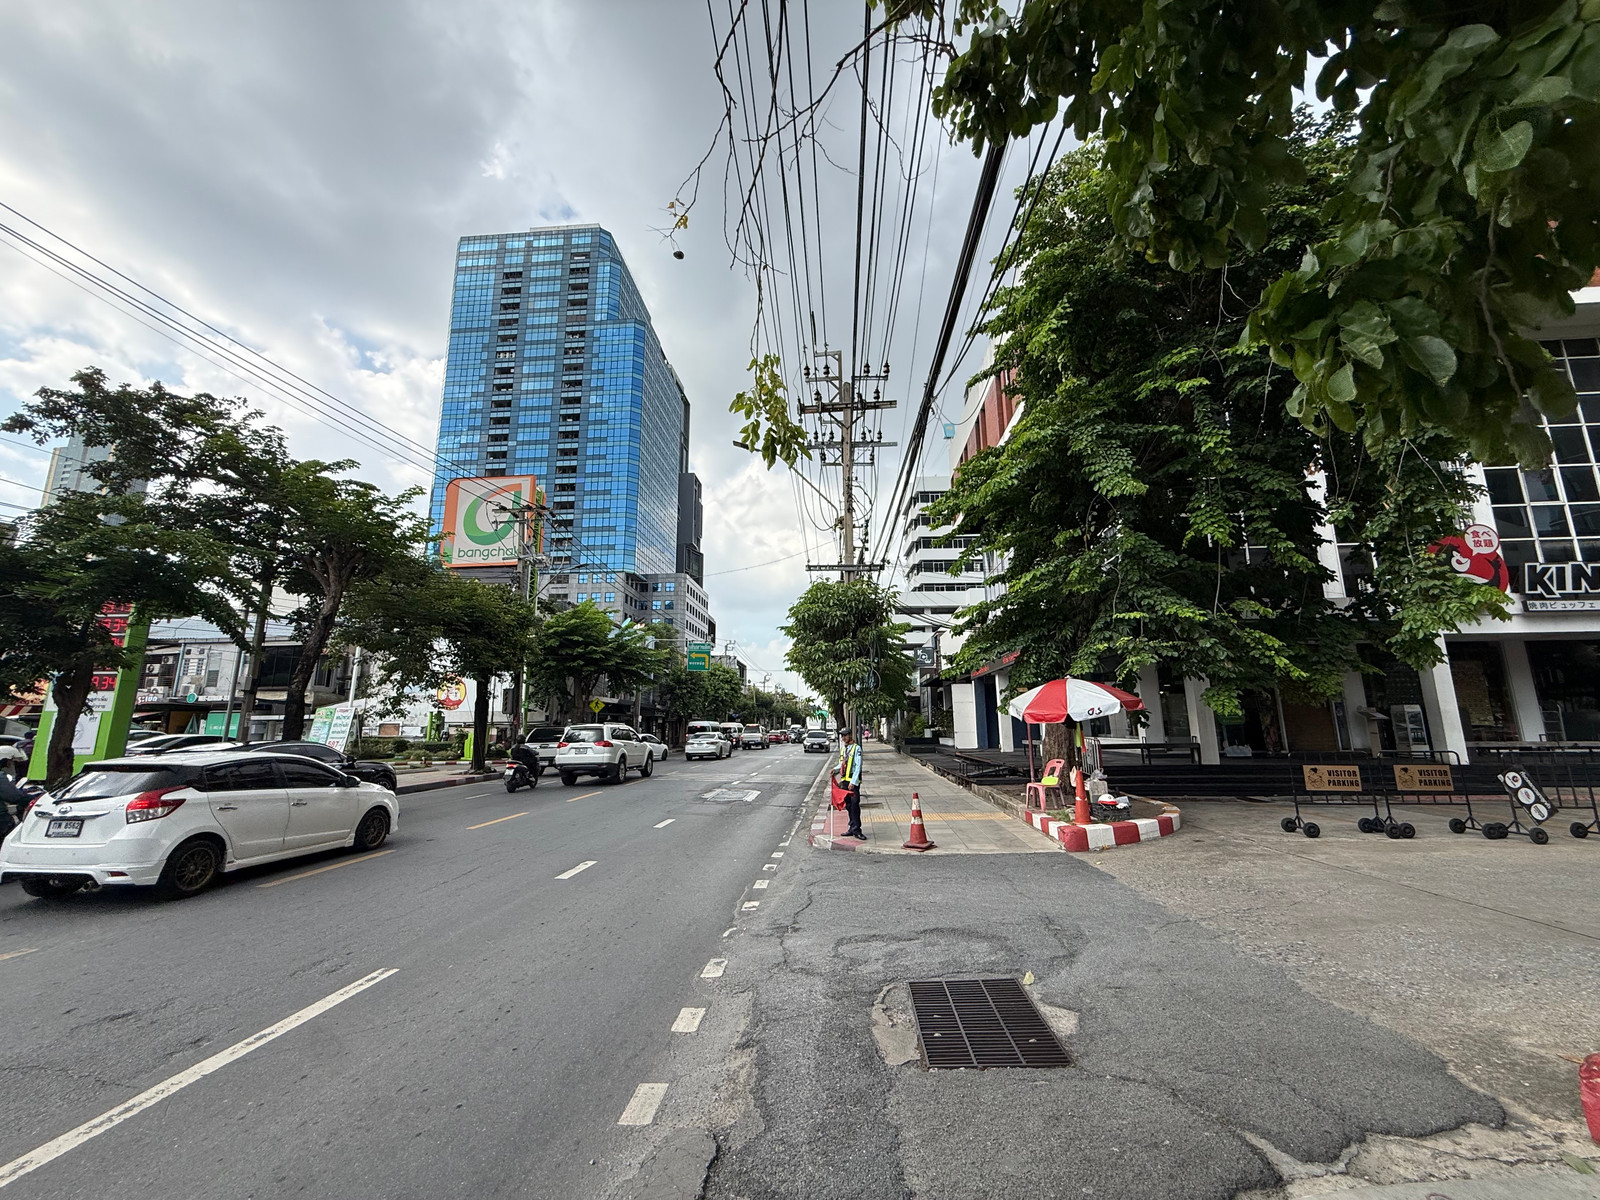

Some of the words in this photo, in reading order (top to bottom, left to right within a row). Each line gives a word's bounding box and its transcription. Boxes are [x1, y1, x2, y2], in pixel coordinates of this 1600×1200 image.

[1470, 529, 1492, 539] 食べ
[1472, 538, 1494, 548] 放題
[1326, 769, 1357, 778] VISITOR
[1417, 769, 1448, 777] VISITOR
[1327, 779, 1360, 787] PARKING
[1418, 779, 1452, 787] PARKING
